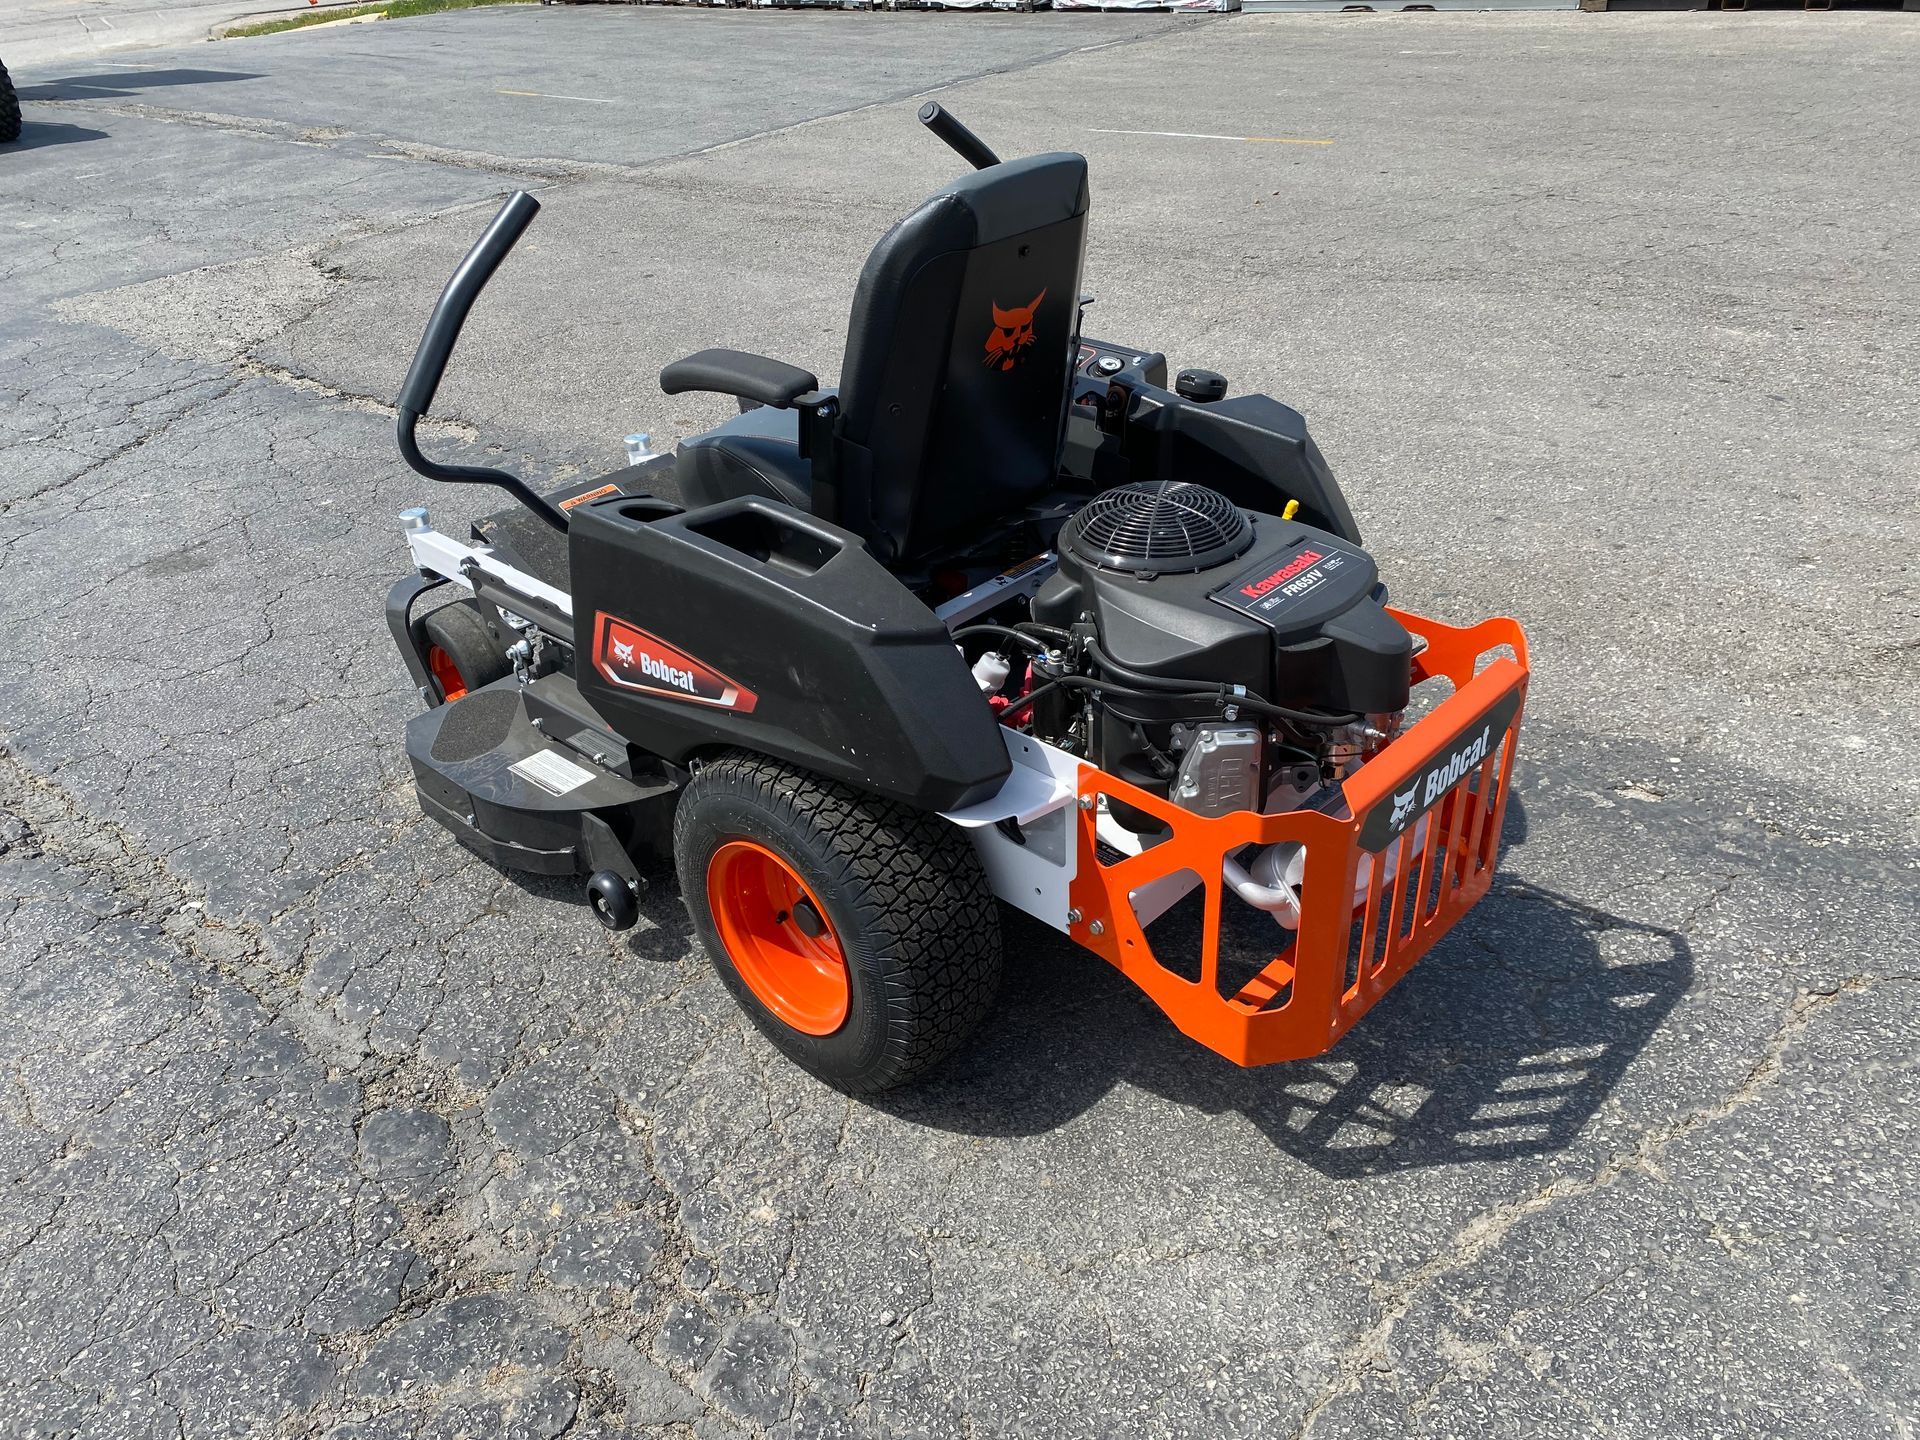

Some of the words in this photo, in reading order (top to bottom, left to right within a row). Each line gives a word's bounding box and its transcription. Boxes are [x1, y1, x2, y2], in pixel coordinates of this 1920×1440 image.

[1239, 549, 1324, 599] Kawasaki
[1281, 569, 1323, 597] FR651V
[639, 652, 695, 693] Bobcat
[1423, 724, 1490, 808] Bobcat
